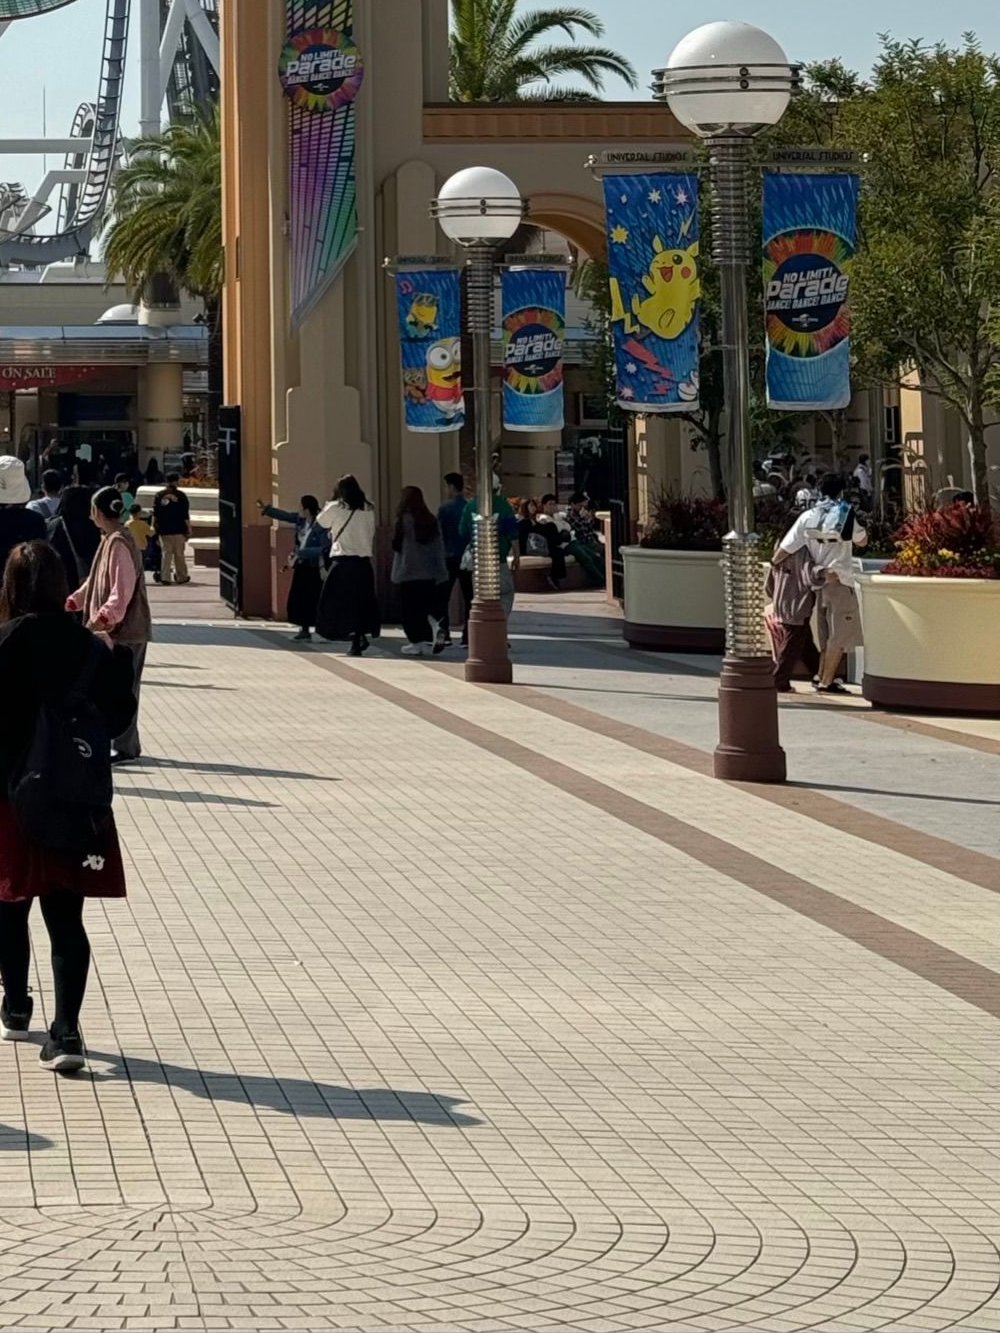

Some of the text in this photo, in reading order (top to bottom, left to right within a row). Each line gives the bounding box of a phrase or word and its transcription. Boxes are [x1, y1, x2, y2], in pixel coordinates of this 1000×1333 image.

[300, 50, 342, 62] NO LIMIT!
[607, 152, 687, 162] UNIVERSAL STUDIOS
[773, 151, 854, 161] UNIVERSAL STUDIOS
[783, 267, 833, 283] NO LIMIT!
[2, 367, 22, 379] ON
[25, 367, 57, 379] SALE
